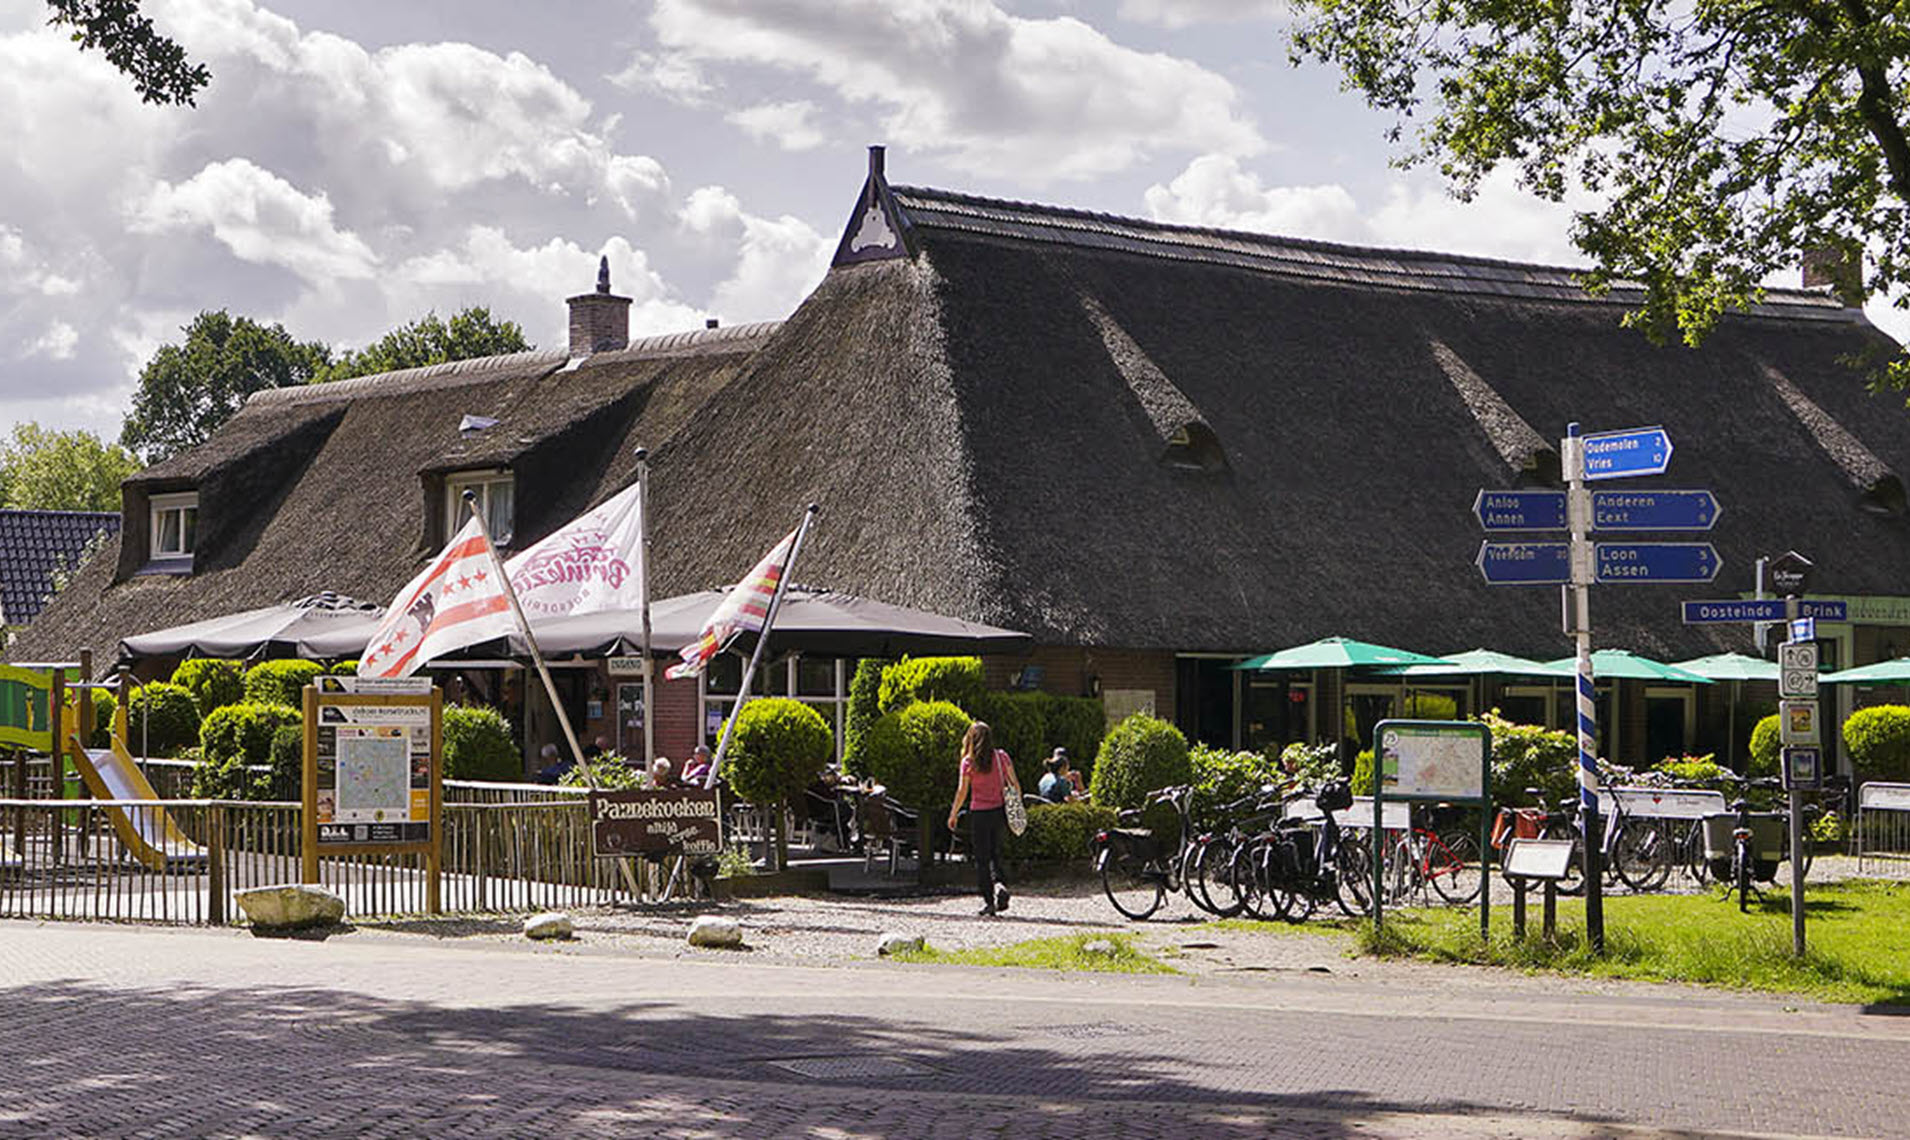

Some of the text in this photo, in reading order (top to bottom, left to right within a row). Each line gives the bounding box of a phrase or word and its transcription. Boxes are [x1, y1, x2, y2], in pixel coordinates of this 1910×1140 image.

[1587, 438, 1639, 454] Oudemolen
[1587, 457, 1612, 469] Vries
[1486, 496, 1520, 509] Anloo
[1597, 495, 1655, 507] Anderen
[1486, 512, 1525, 525] Annen
[1597, 511, 1629, 523] Eext
[1600, 548, 1637, 560] Loon
[1602, 563, 1648, 576] Assen
[1700, 606, 1772, 619] Oosteinde
[1803, 604, 1843, 617] Brink
[596, 797, 716, 820] Pannekoeken
